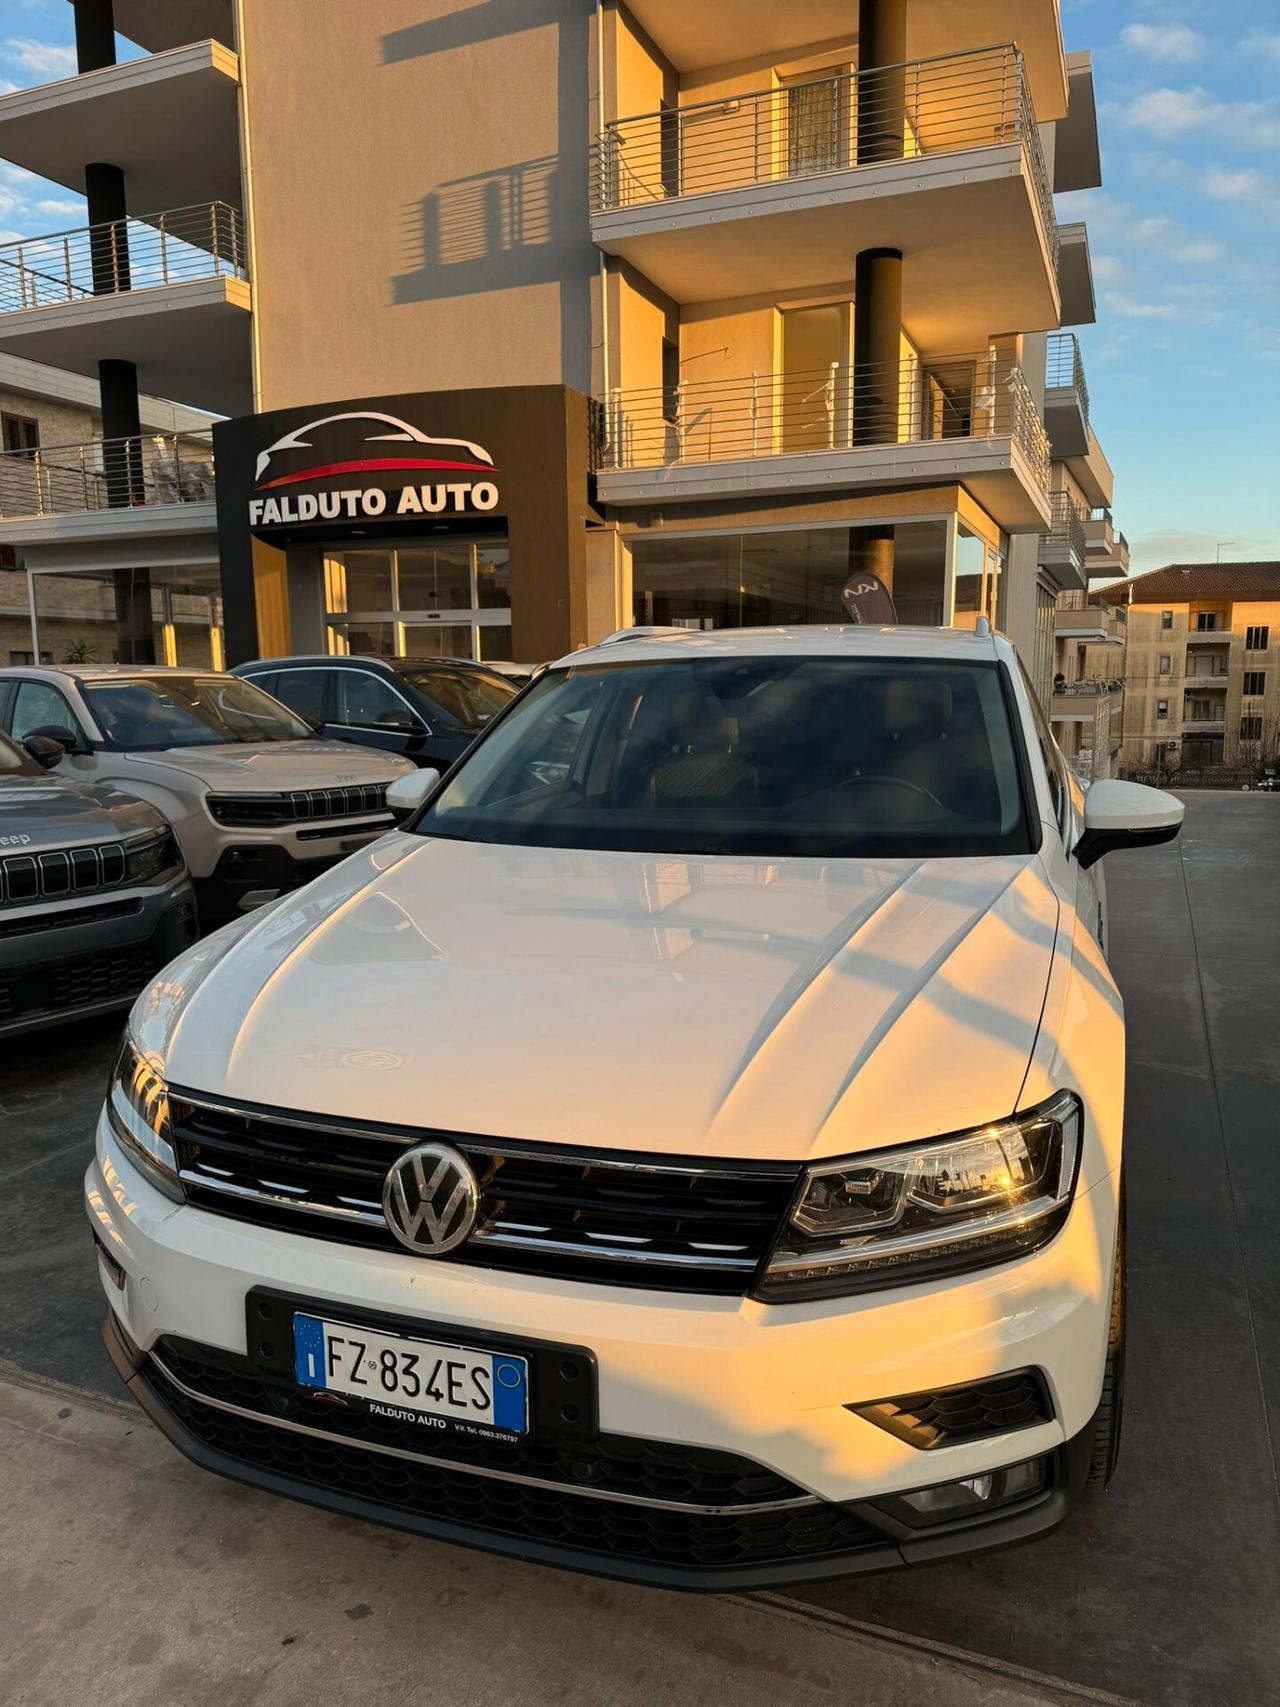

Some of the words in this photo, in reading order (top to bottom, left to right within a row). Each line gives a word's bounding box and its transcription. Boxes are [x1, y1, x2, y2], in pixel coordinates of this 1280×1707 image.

[248, 488, 387, 526] FALDUTO
[396, 481, 500, 515] AUTO
[0, 835, 31, 846] eep
[369, 1403, 416, 1424] FALDUTO
[417, 1413, 447, 1430] AUTO
